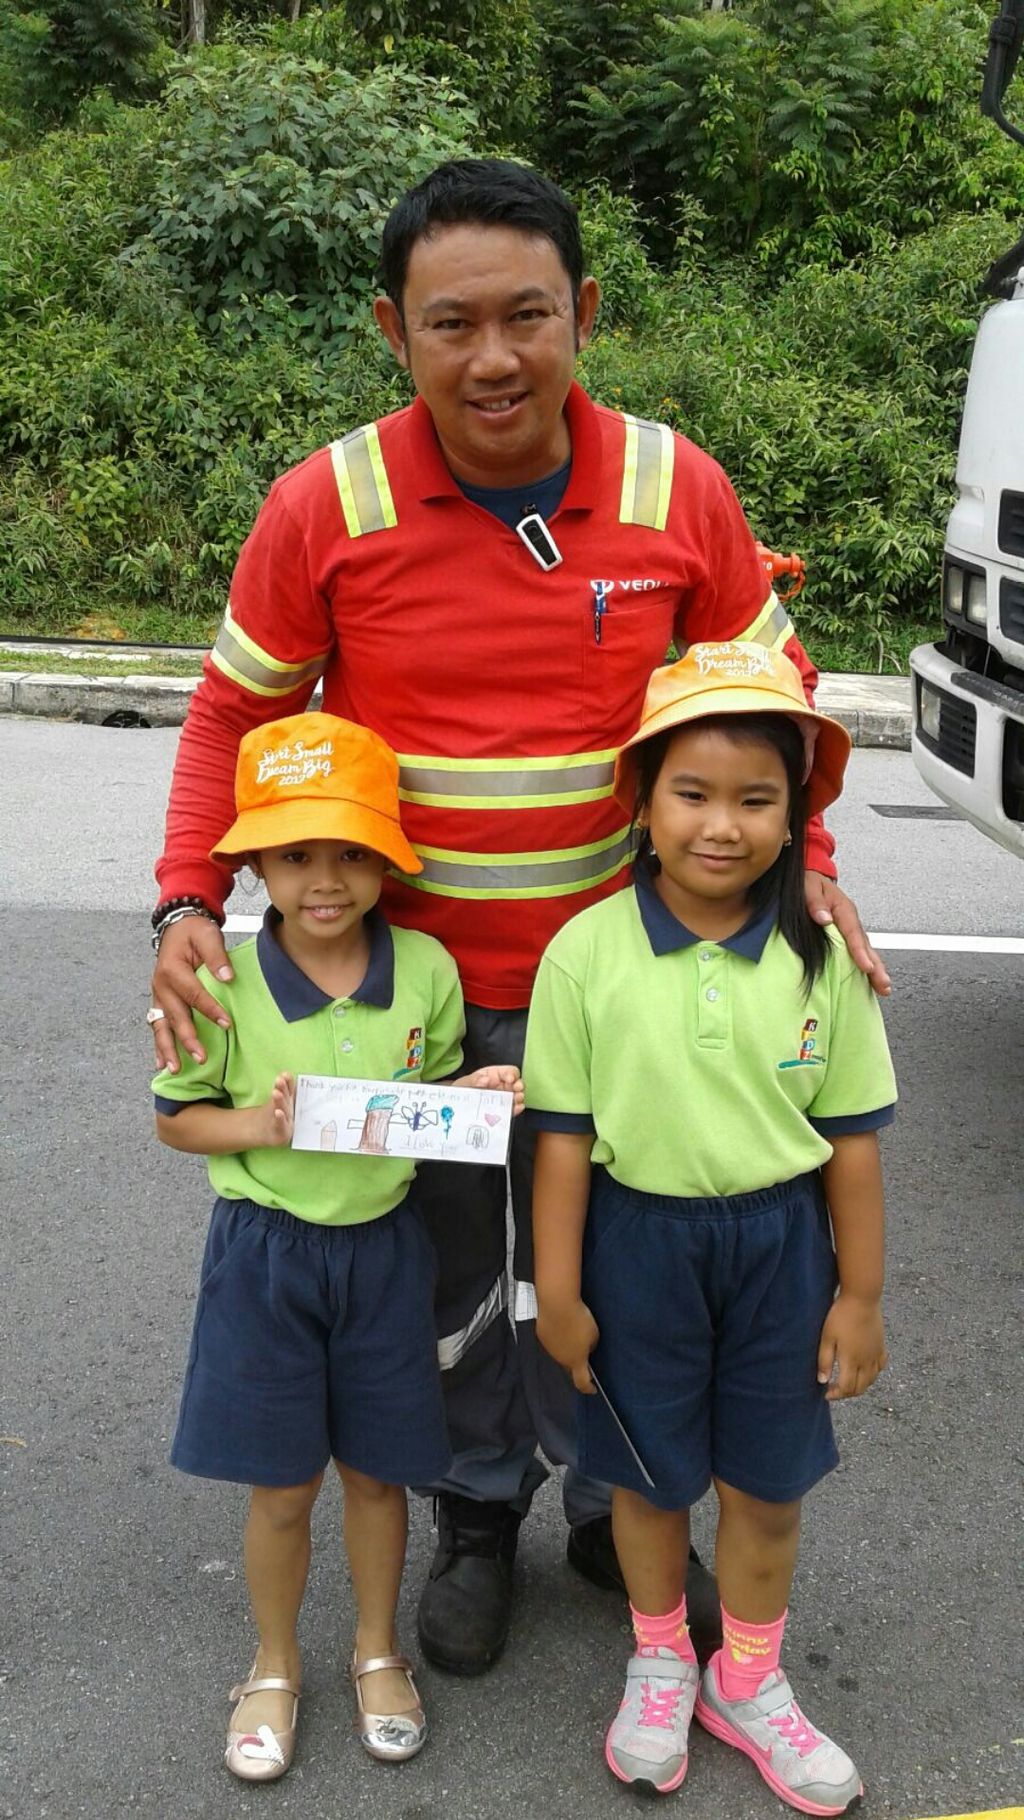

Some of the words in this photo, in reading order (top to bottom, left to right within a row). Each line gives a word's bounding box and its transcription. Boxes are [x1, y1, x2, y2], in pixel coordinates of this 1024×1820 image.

[292, 741, 334, 761] Small
[256, 760, 301, 784] Dream
[303, 758, 333, 779] Big
[278, 774, 306, 786] 2017
